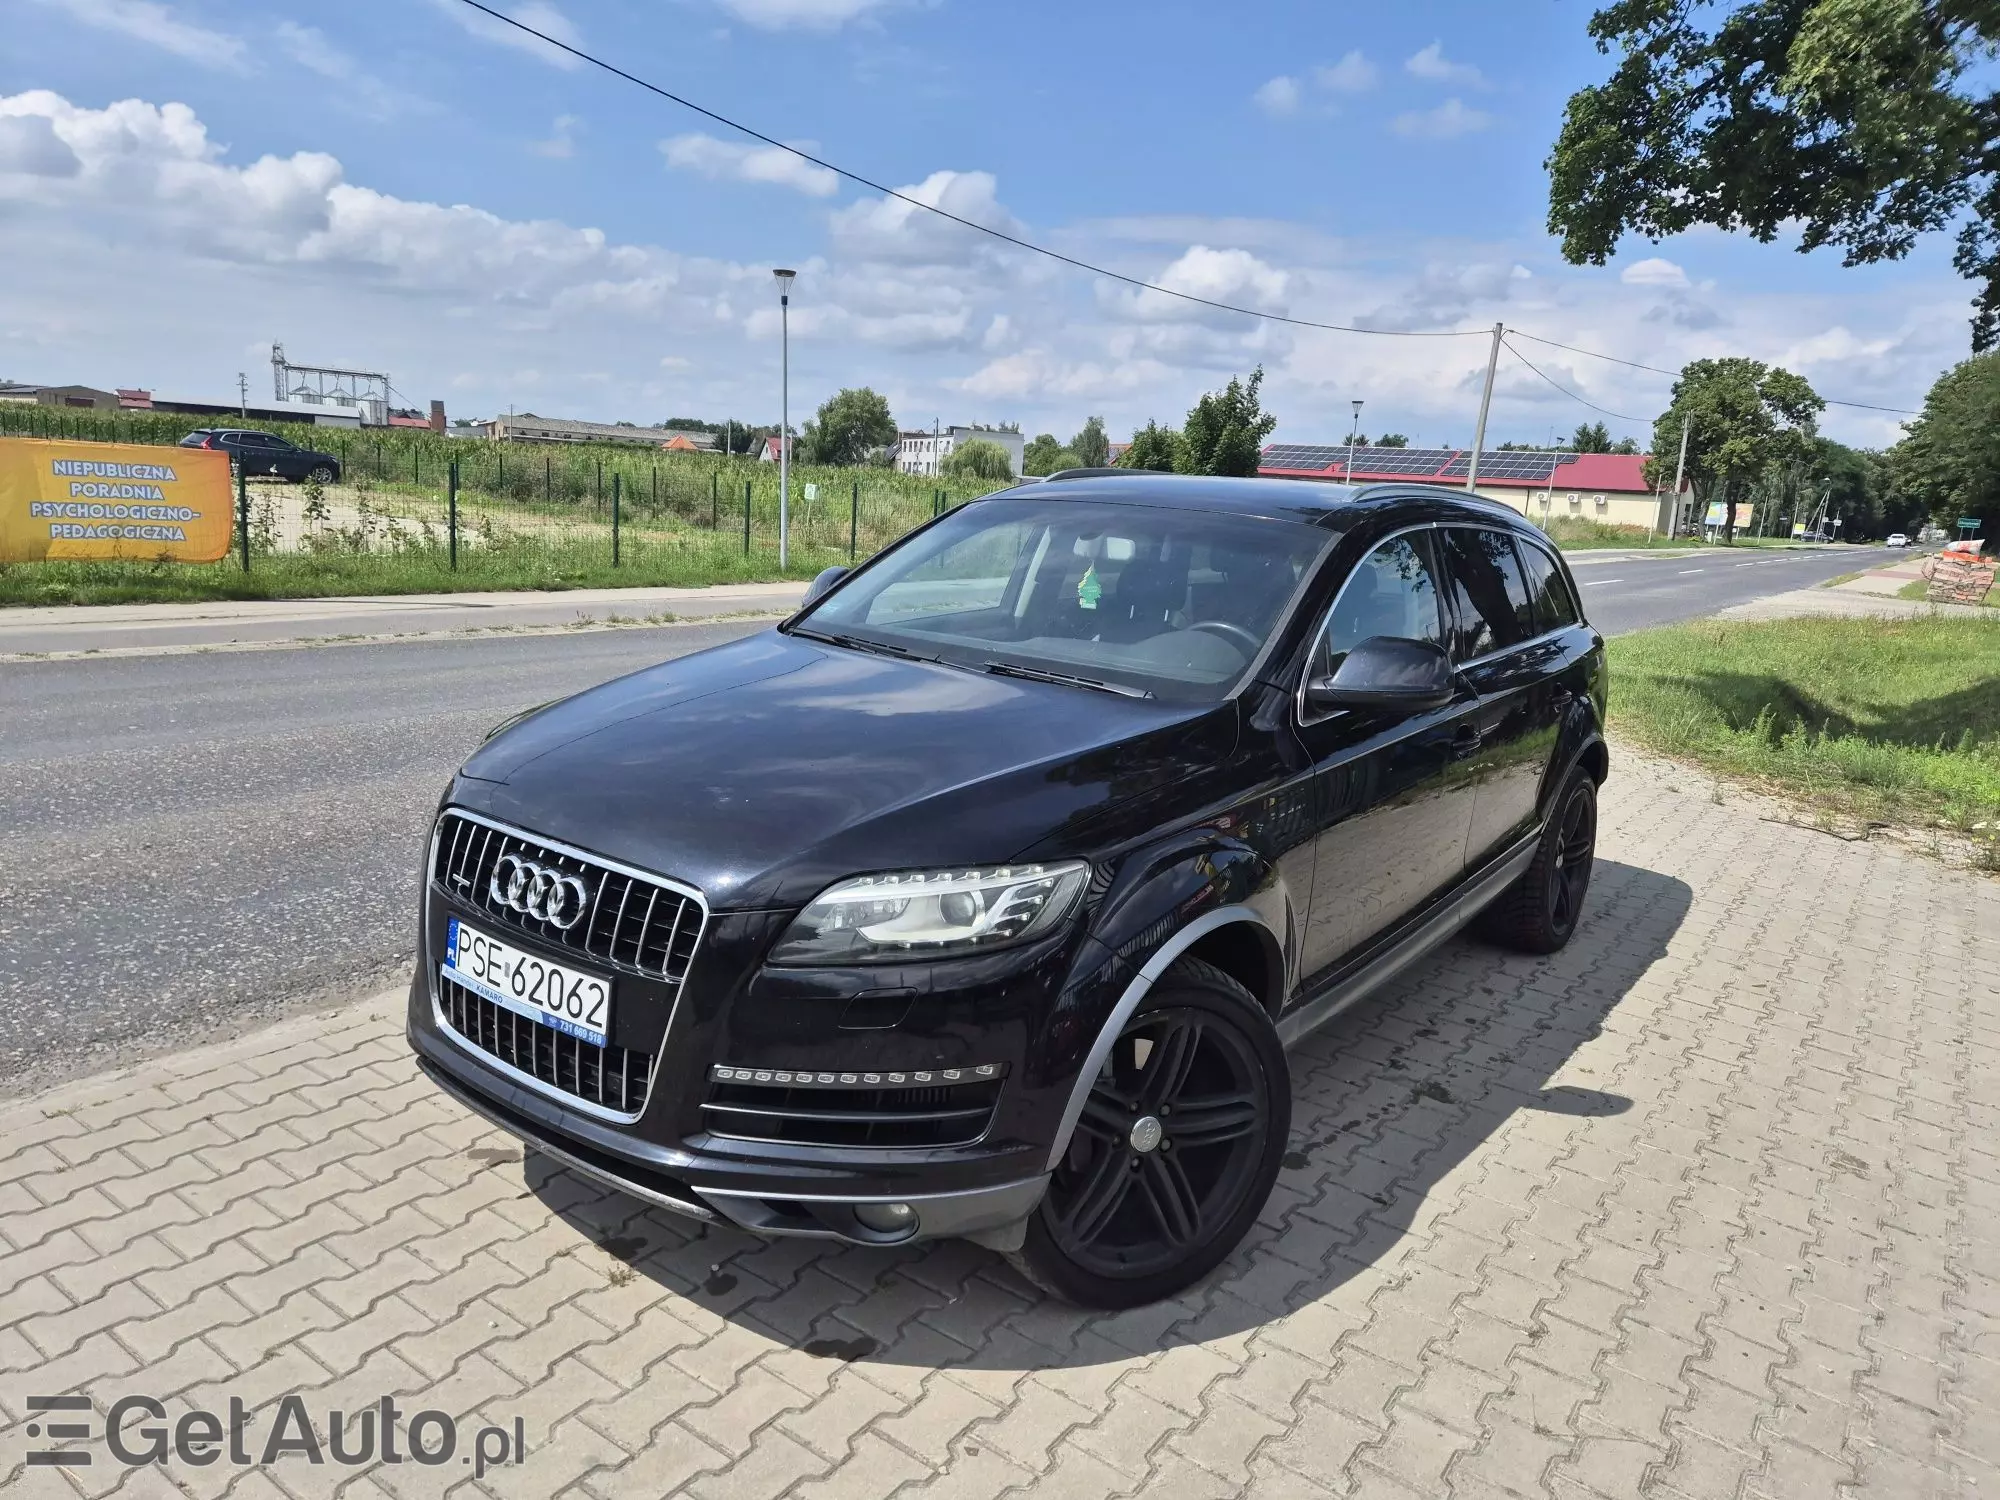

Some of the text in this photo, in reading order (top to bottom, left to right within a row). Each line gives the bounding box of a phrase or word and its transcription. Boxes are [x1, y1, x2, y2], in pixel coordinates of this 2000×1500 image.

[53, 459, 177, 481] NIEPUBLICZNA
[70, 482, 164, 500] PORADNIA
[31, 502, 200, 521] PSYCHOLOGICZNO-
[50, 524, 186, 541] PEDAGOGICZNA
[447, 947, 456, 961] PL
[457, 927, 605, 1029] PSE 62062
